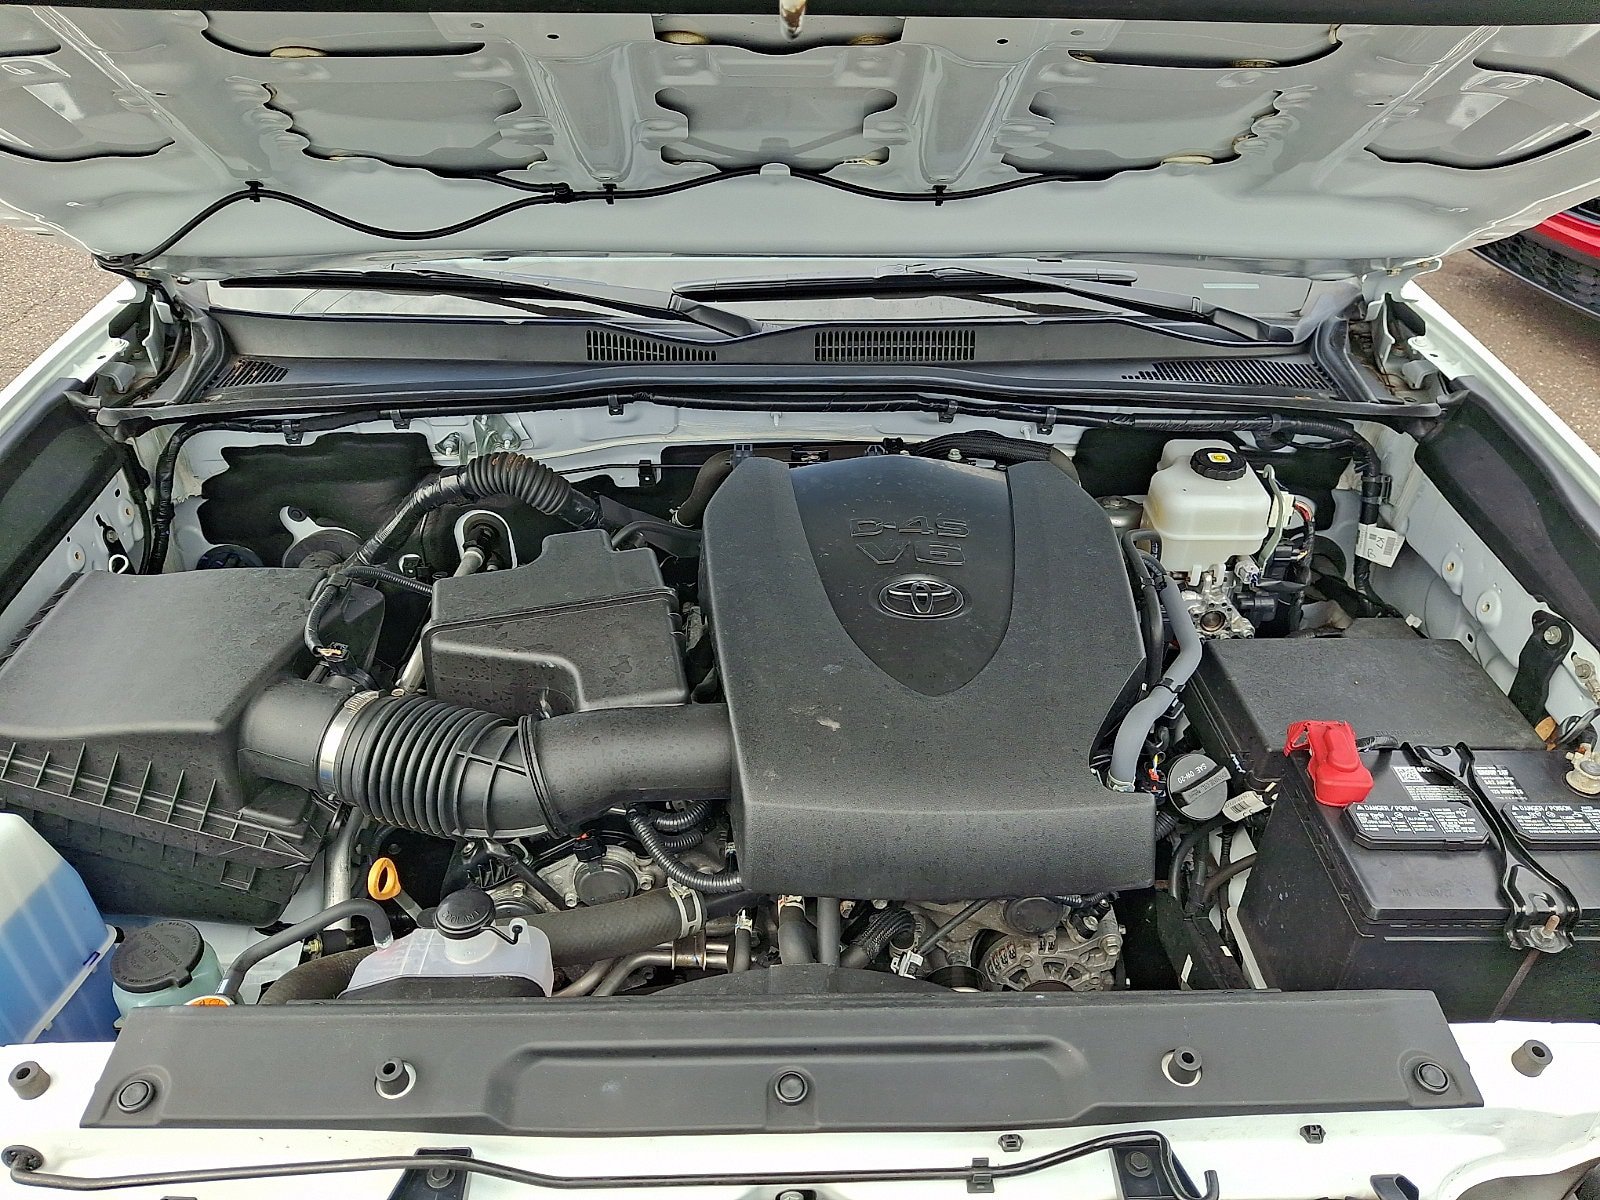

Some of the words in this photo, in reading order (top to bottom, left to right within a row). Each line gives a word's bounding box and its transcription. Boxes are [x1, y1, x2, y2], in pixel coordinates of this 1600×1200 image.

[849, 515, 970, 538] D-4S
[856, 541, 966, 566] V6
[1177, 770, 1195, 784] 0W-20
[1194, 762, 1207, 774] SAE
